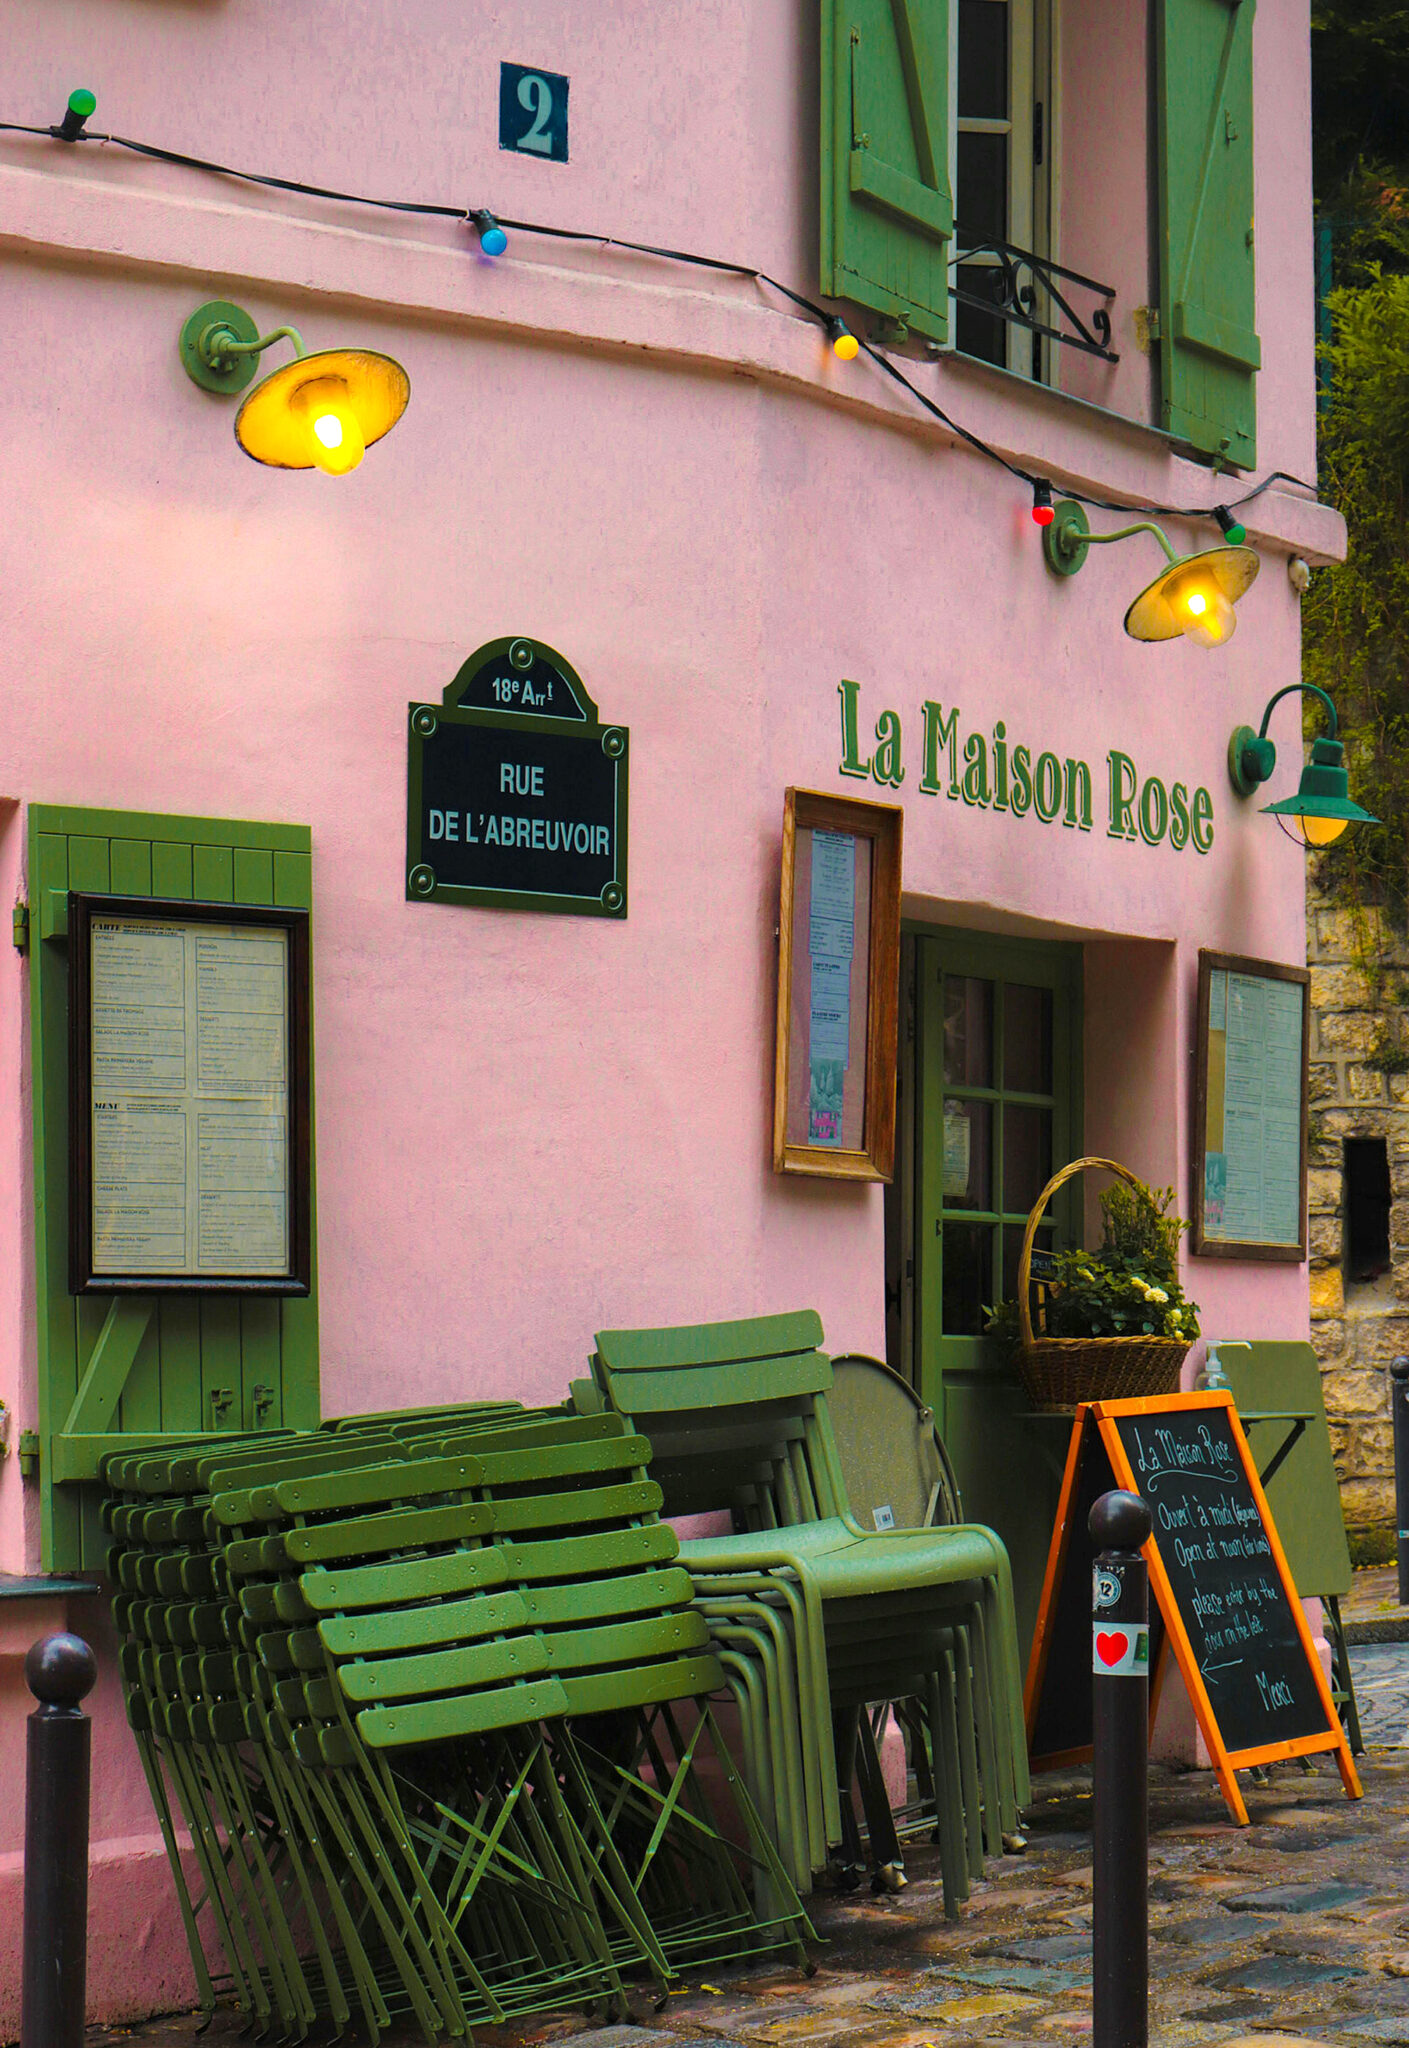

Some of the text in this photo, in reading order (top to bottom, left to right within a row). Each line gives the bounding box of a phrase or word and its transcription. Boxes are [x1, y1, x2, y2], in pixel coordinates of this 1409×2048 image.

[517, 74, 552, 154] 2
[500, 763, 544, 796] RUE
[838, 679, 1214, 854] La Maison Rose
[429, 809, 609, 855] DE L'ABREUVOIR
[1138, 1424, 1234, 1472] La Maison Rose
[1158, 1494, 1198, 1531] Ouvert
[1192, 1495, 1210, 1528] à
[1208, 1492, 1236, 1527] midi
[1174, 1537, 1206, 1580] Open
[1206, 1532, 1220, 1560] at
[1220, 1538, 1248, 1559] noon
[1100, 1581, 1113, 1598] 12
[1191, 1586, 1226, 1629] please
[1243, 1581, 1262, 1607] by
[1259, 1577, 1279, 1601] the
[1255, 1670, 1295, 1712] Merci
